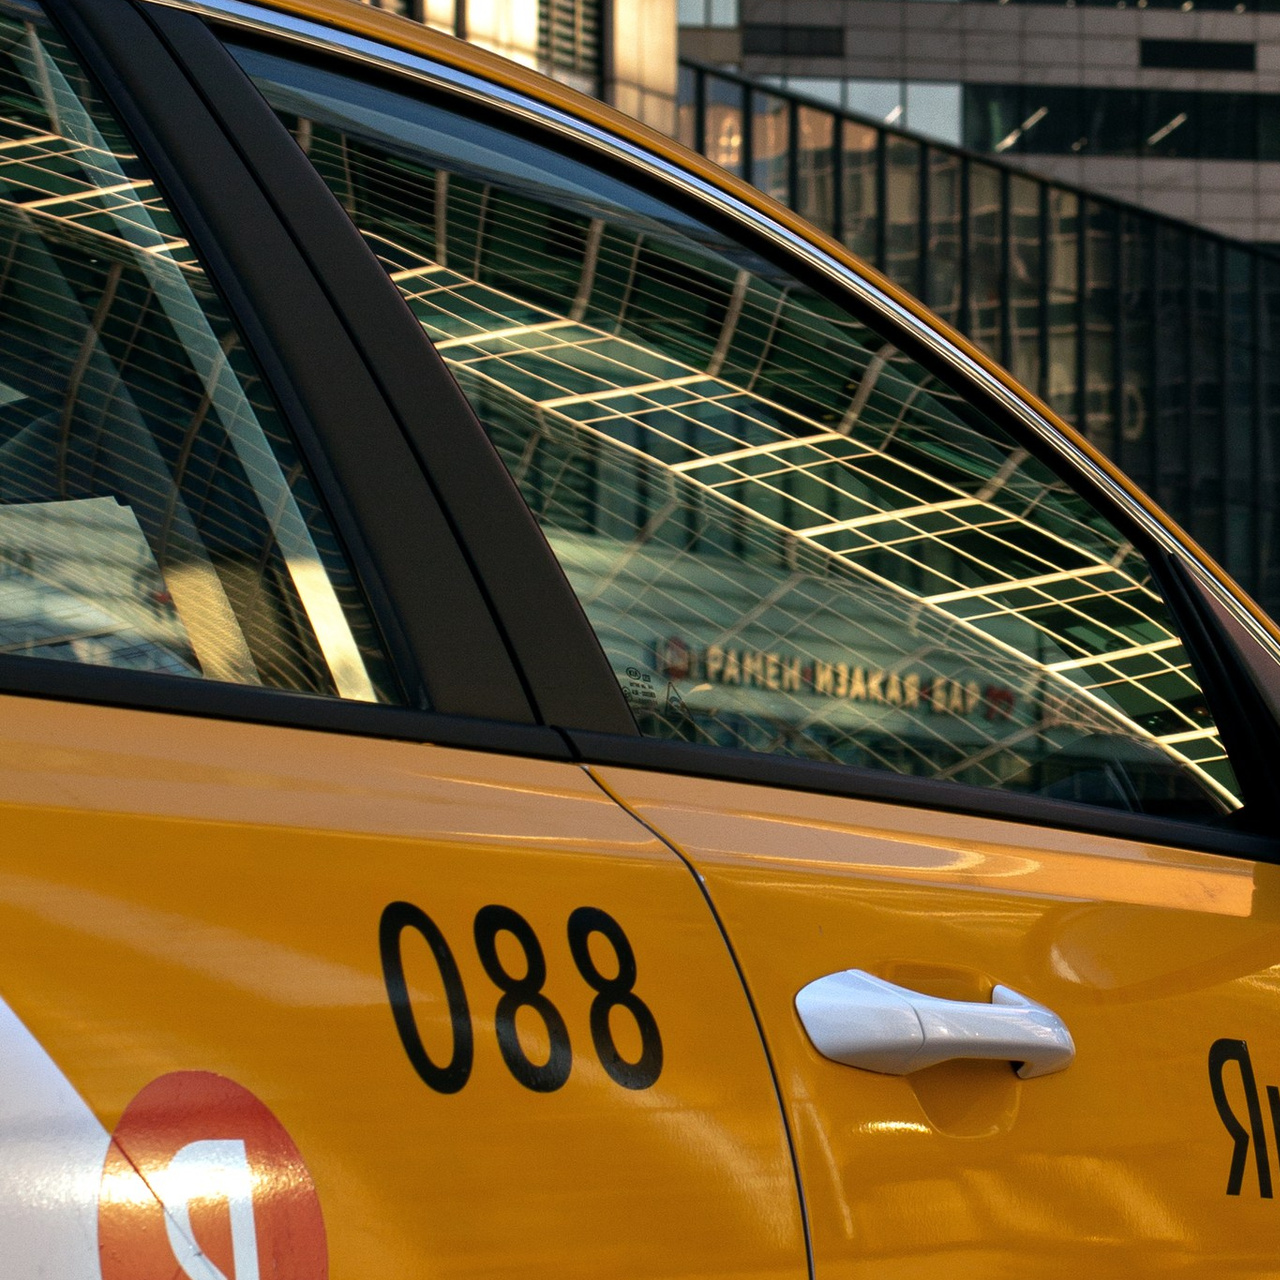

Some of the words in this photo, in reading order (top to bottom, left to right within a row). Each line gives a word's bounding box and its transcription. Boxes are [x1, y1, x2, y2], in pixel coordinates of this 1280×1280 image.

[706, 644, 800, 692] РАМЕН
[815, 660, 920, 708] ИЗАКАЯ
[931, 675, 981, 713] БАР
[379, 901, 664, 1095] 088
